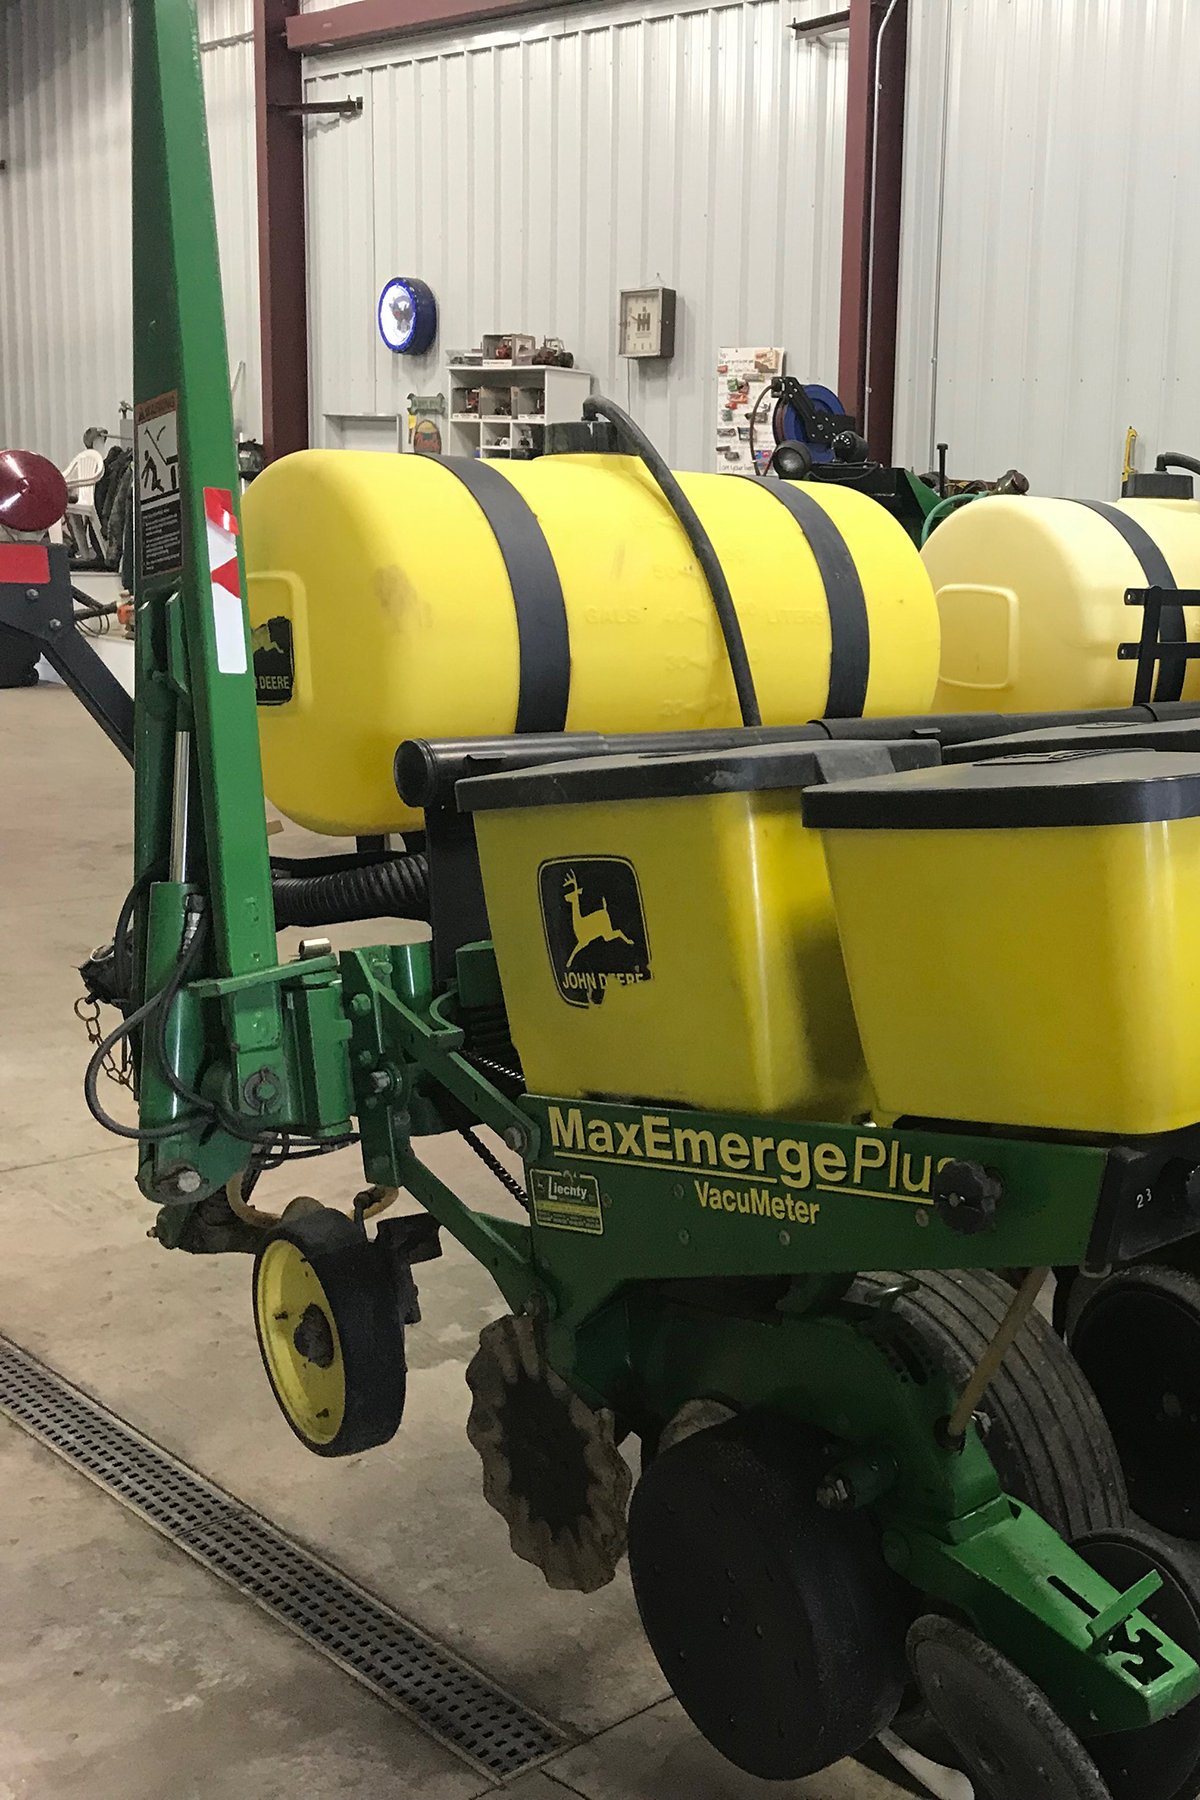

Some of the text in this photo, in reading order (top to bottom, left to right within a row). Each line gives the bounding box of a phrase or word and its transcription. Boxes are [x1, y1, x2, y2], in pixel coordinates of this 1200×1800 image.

[584, 606, 640, 625] GALS
[259, 675, 290, 690] DEERE
[562, 972, 598, 990] JOHN
[694, 1179, 820, 1225] VacuMeter
